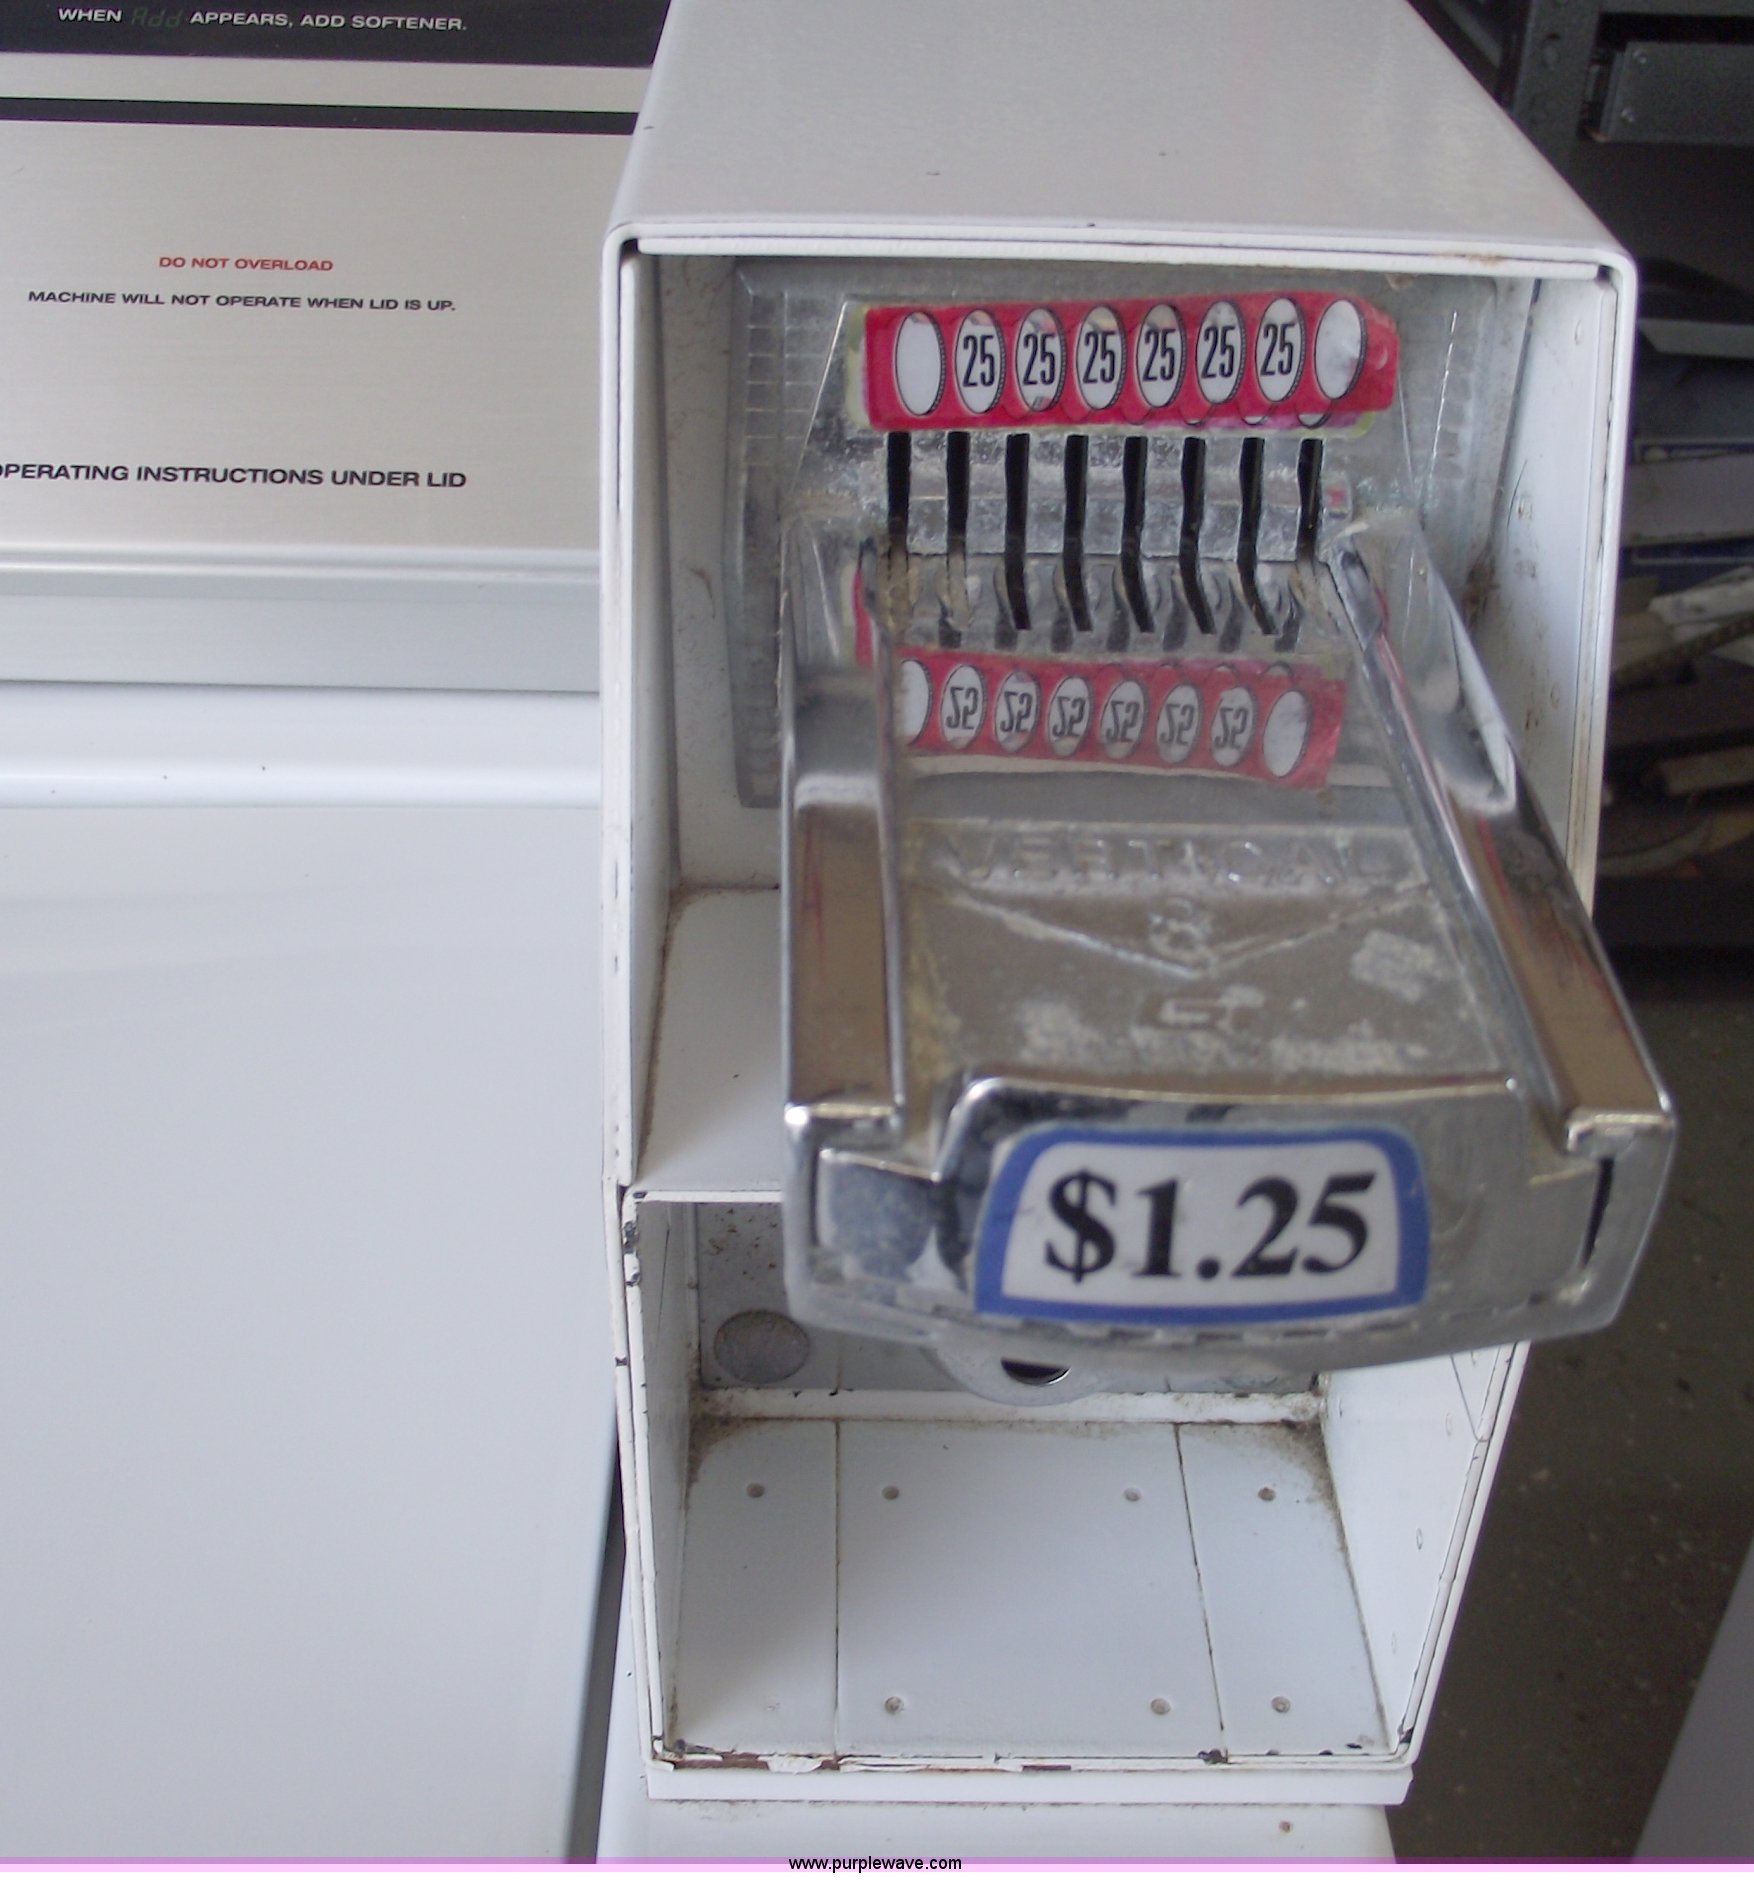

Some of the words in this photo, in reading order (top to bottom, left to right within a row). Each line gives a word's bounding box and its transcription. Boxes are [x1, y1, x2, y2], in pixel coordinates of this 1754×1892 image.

[58, 8, 122, 22] WHEN
[190, 12, 293, 28] APPEARS,
[300, 15, 345, 28] ADD
[352, 15, 467, 30] SOFTENER.
[159, 257, 186, 268] DO
[191, 258, 229, 268] NOT
[234, 258, 333, 271] OVERLOAD
[28, 291, 116, 304] MACHINE
[122, 293, 165, 305] WILL
[171, 295, 210, 305] NOT
[216, 295, 301, 308] OPERATE
[307, 297, 363, 309] WHEN
[369, 299, 399, 310] LID
[404, 300, 421, 310] IS
[427, 300, 456, 311] UP.
[962, 335, 996, 388] 25
[1022, 334, 1056, 385] 25
[1083, 331, 1116, 384] 25
[1143, 328, 1176, 382] 25
[1201, 325, 1235, 379] 25
[1260, 322, 1296, 376] 25
[0, 464, 129, 481] PERATING
[136, 466, 323, 485] INSTRUCTIONS
[331, 470, 420, 486] UNDER
[426, 472, 467, 487] LID
[1044, 1168, 1378, 1284] $1.25
